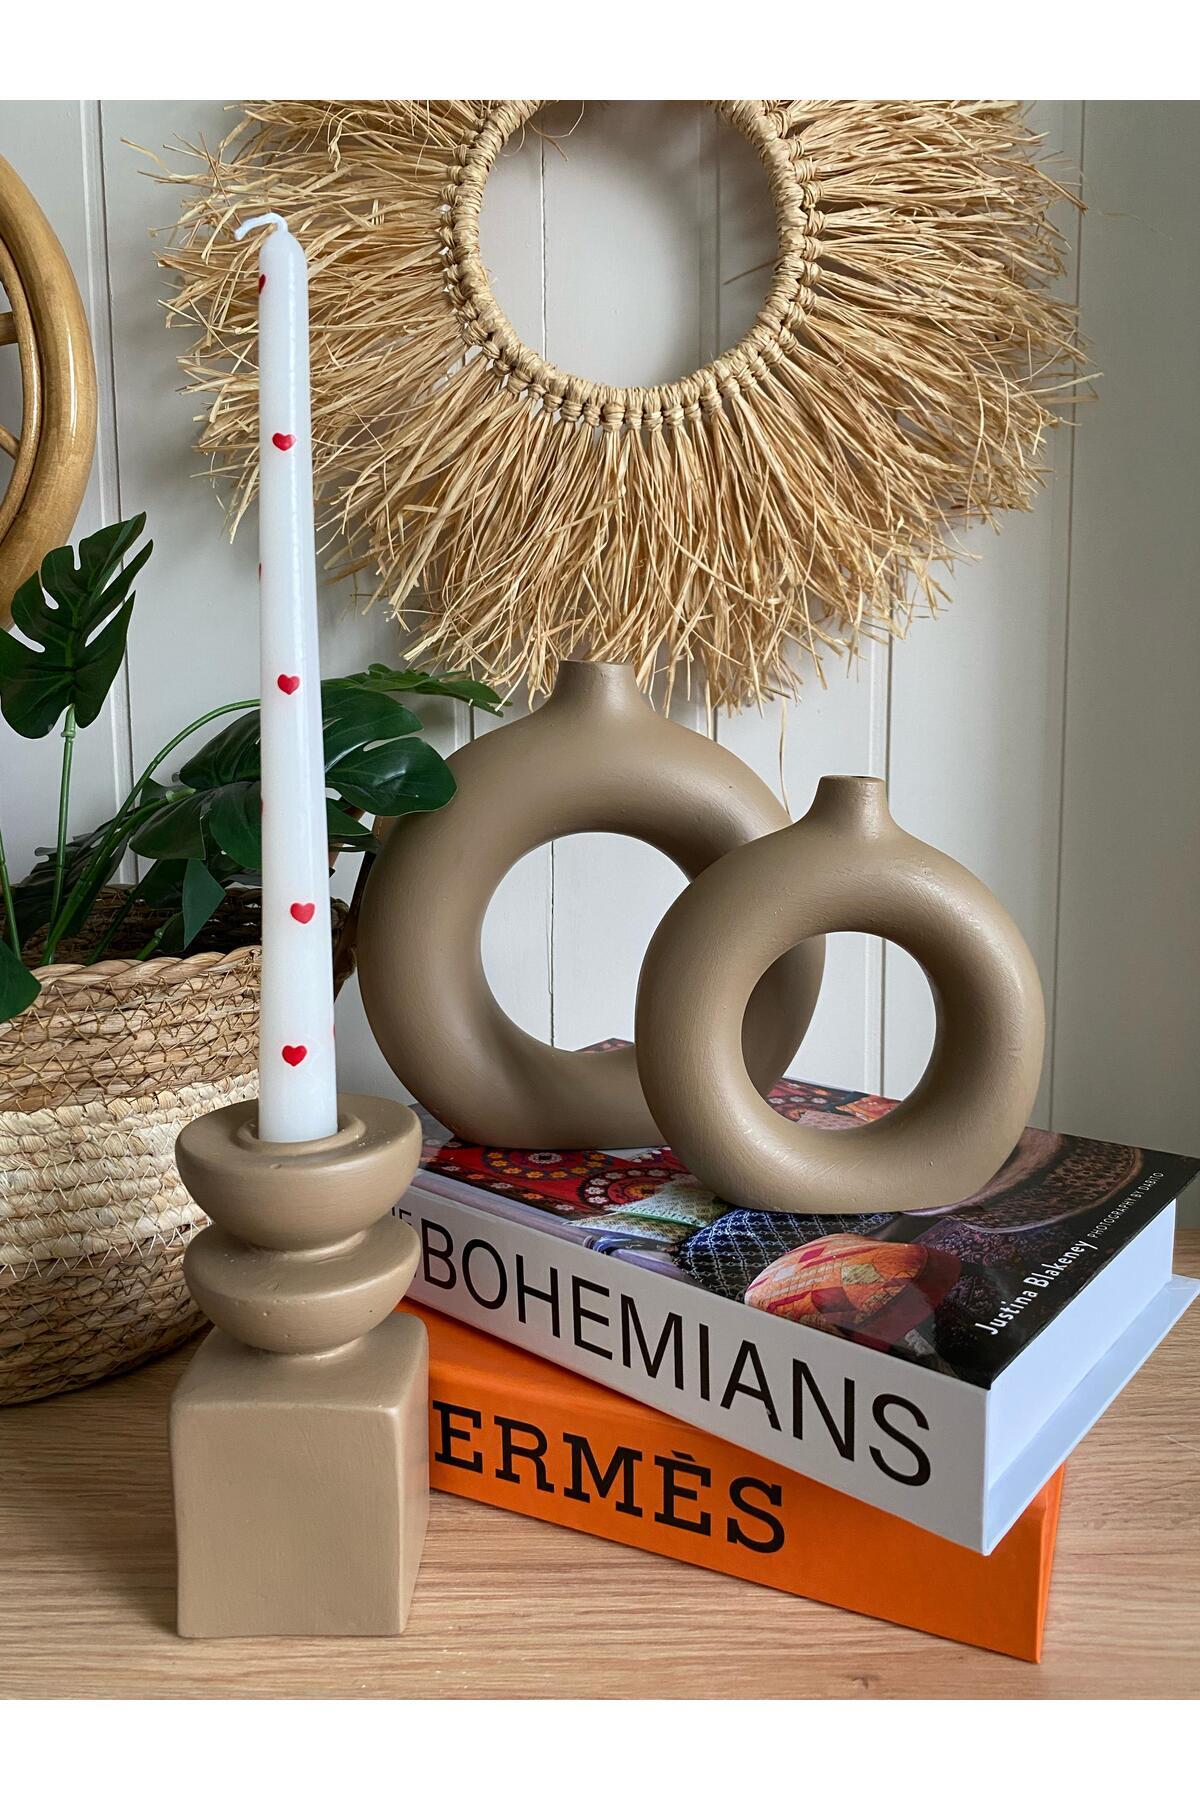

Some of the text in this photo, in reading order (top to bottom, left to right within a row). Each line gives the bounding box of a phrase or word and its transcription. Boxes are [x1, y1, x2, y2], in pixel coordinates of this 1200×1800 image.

[421, 1217, 932, 1487] BOHEMIANS
[975, 1172, 1164, 1335] Justina Blakeney PHOTOGRAPHY BY DABITO
